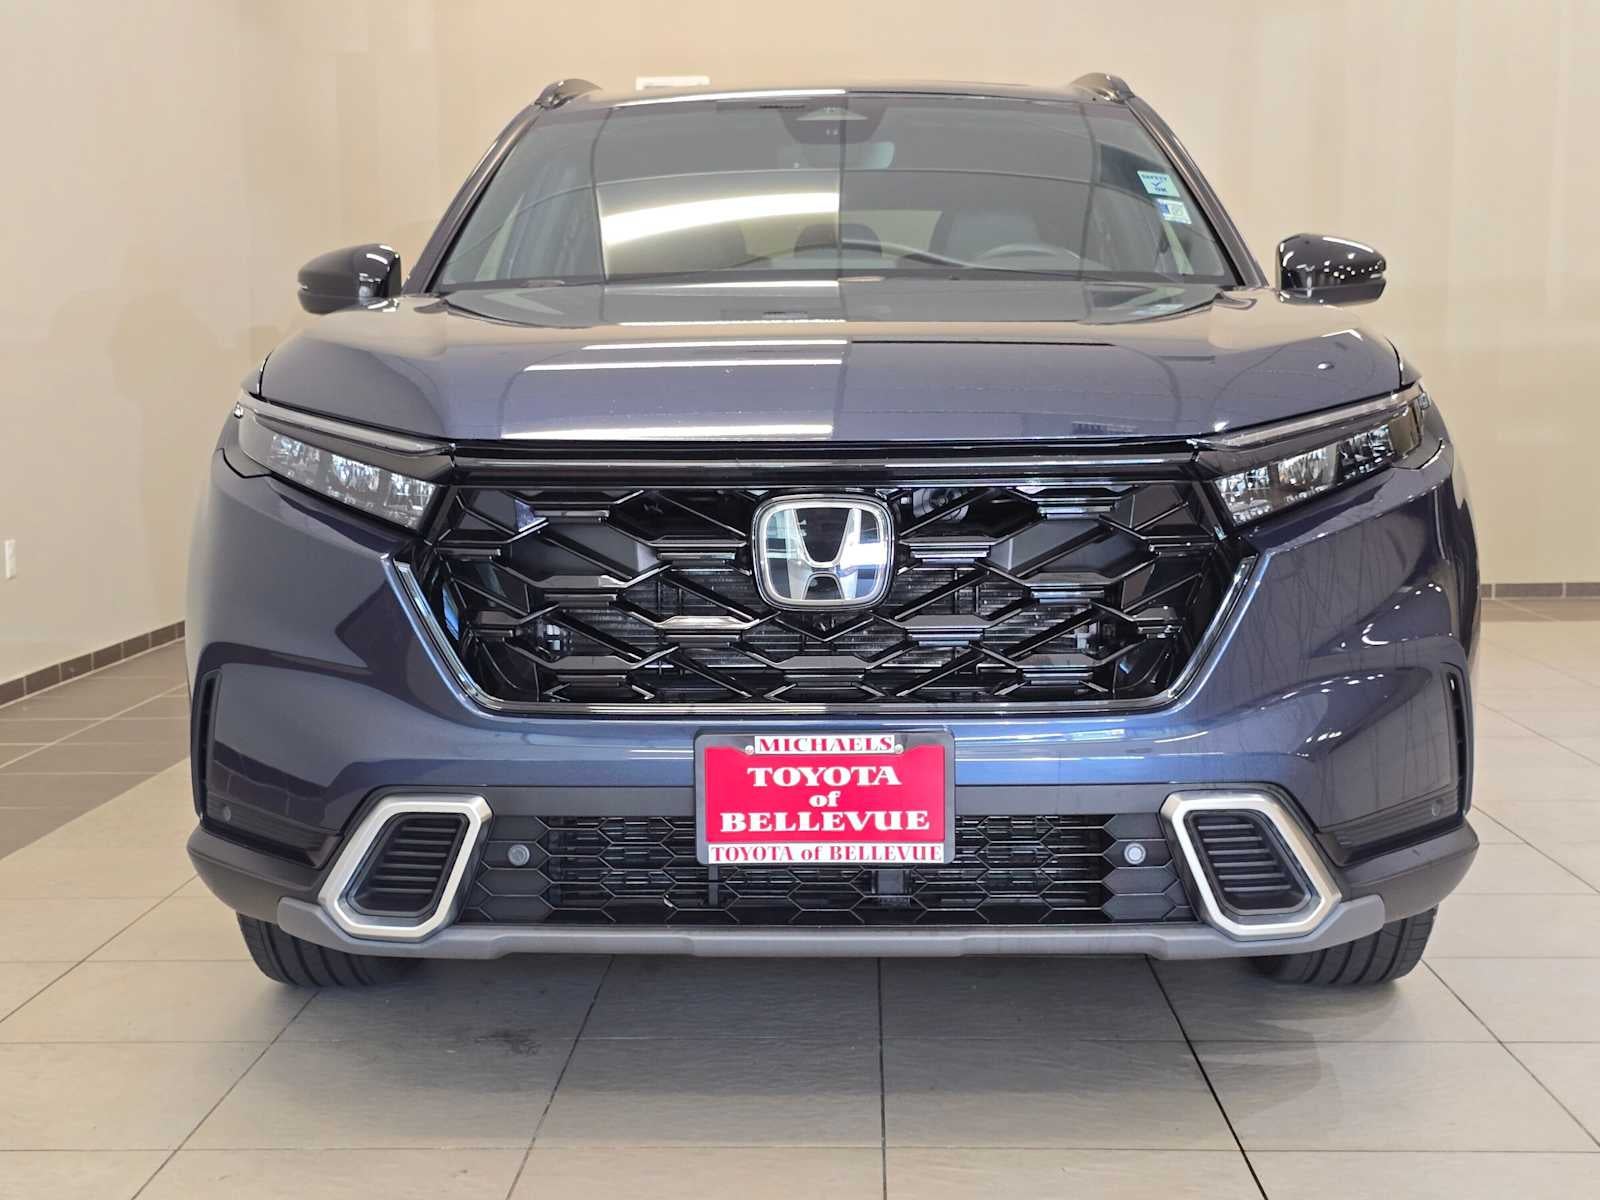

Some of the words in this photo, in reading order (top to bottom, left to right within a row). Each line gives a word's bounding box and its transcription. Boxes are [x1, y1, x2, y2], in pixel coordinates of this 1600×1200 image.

[758, 736, 894, 753] MICHAELS
[747, 765, 902, 788] TOYOTA
[808, 790, 842, 808] of
[719, 810, 931, 833] BELLEVUE
[710, 845, 794, 862] TOYOTA
[800, 845, 823, 862] of
[829, 844, 943, 862] BELLEVUE
